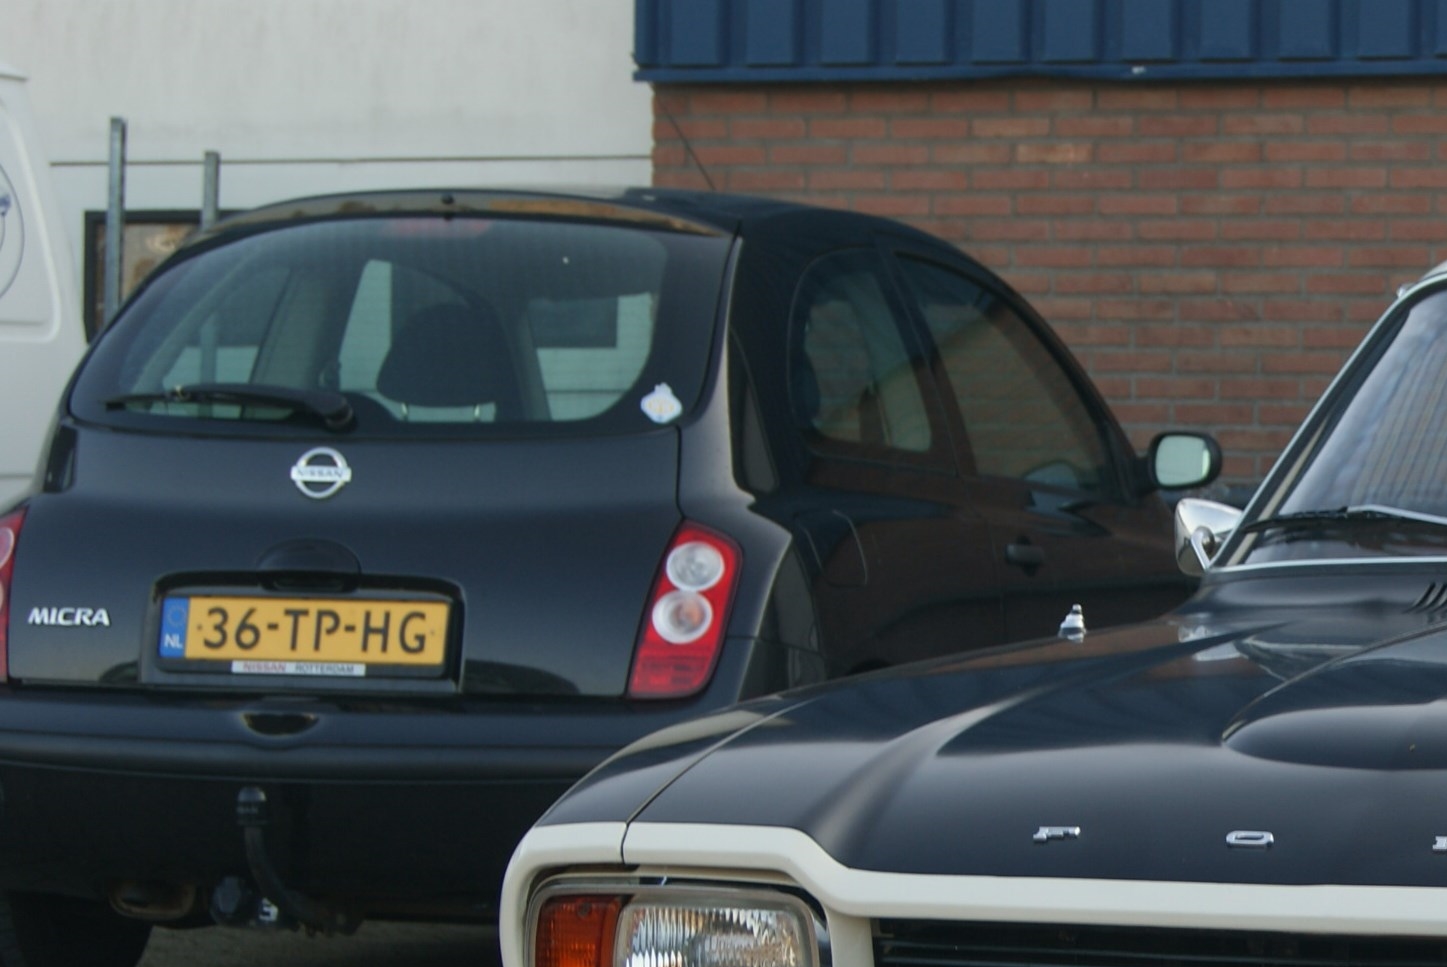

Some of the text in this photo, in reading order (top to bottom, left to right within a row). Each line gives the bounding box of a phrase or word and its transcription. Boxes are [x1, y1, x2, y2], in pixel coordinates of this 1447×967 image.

[27, 606, 110, 626] MICRA
[203, 606, 427, 654] 36-TP-HG
[163, 633, 183, 648] NL
[242, 661, 355, 675] NISSAN ROTTERDAM
